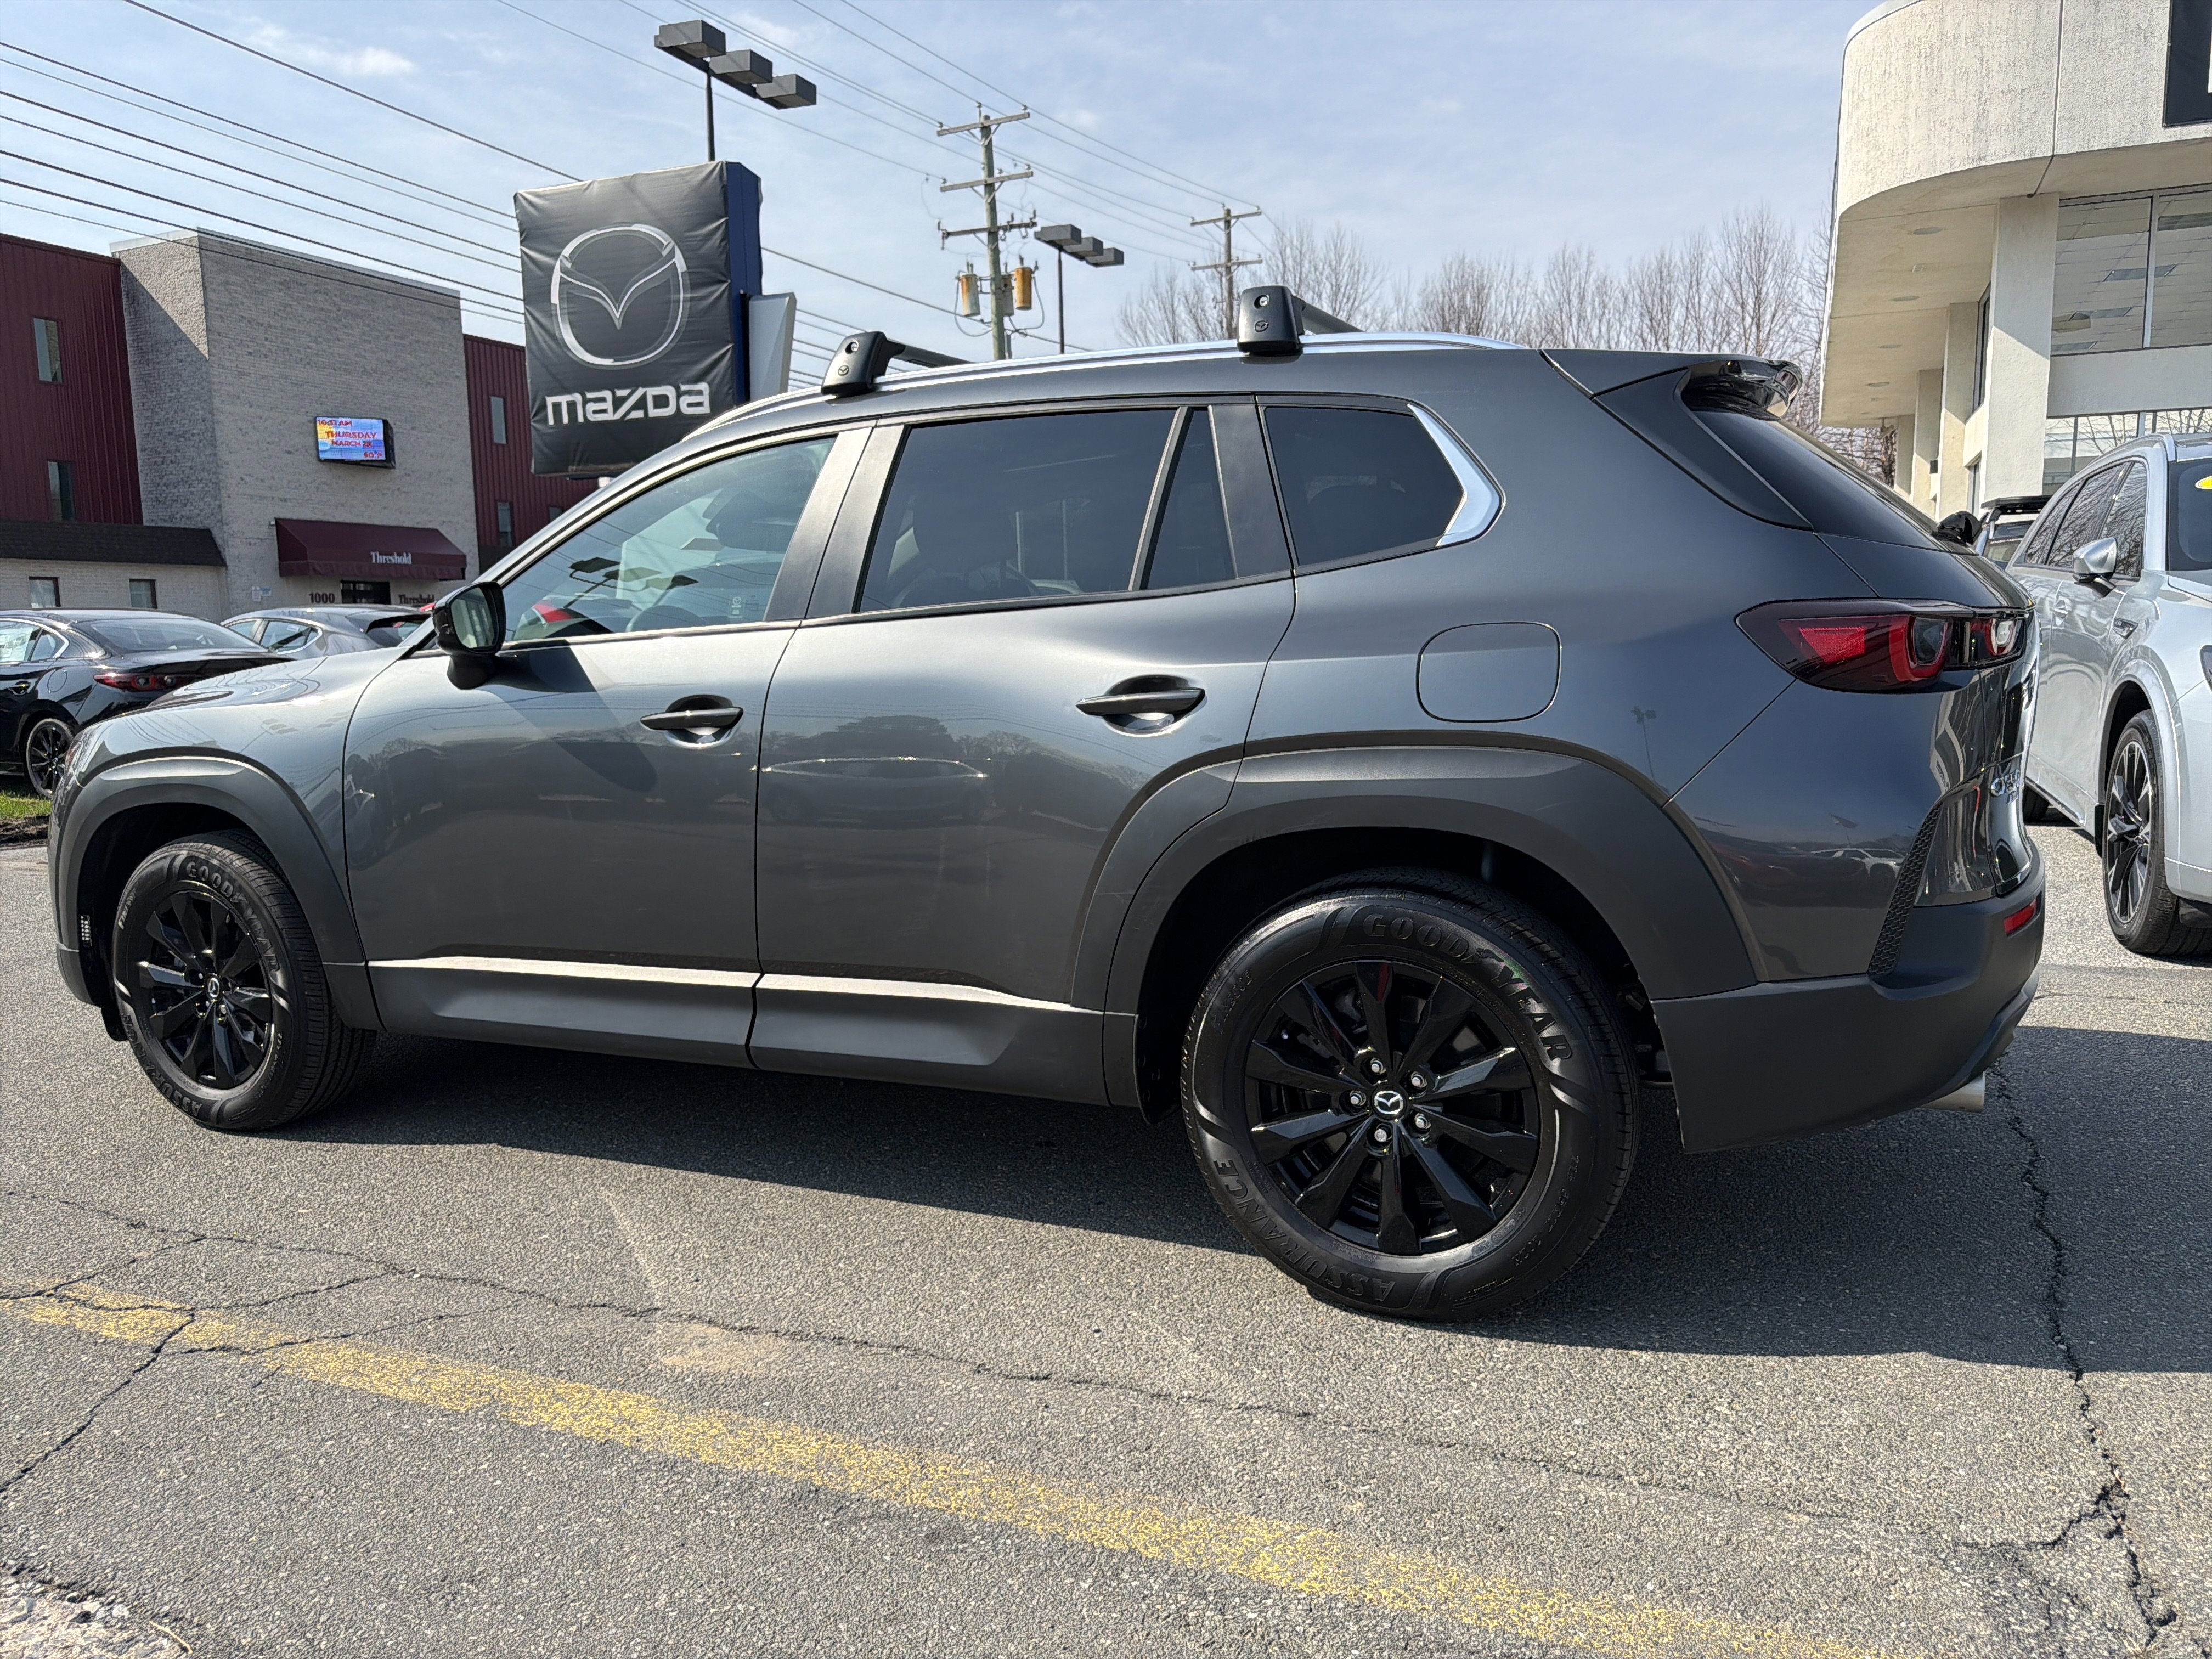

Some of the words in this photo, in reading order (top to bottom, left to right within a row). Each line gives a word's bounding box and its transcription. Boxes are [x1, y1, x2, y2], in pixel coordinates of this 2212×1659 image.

[325, 430, 377, 439] THURSDAY
[370, 551, 411, 565] Threshold
[309, 592, 335, 603] 1000
[398, 594, 435, 605] Threshold
[1212, 1159, 1396, 1302] ASSURANCE
